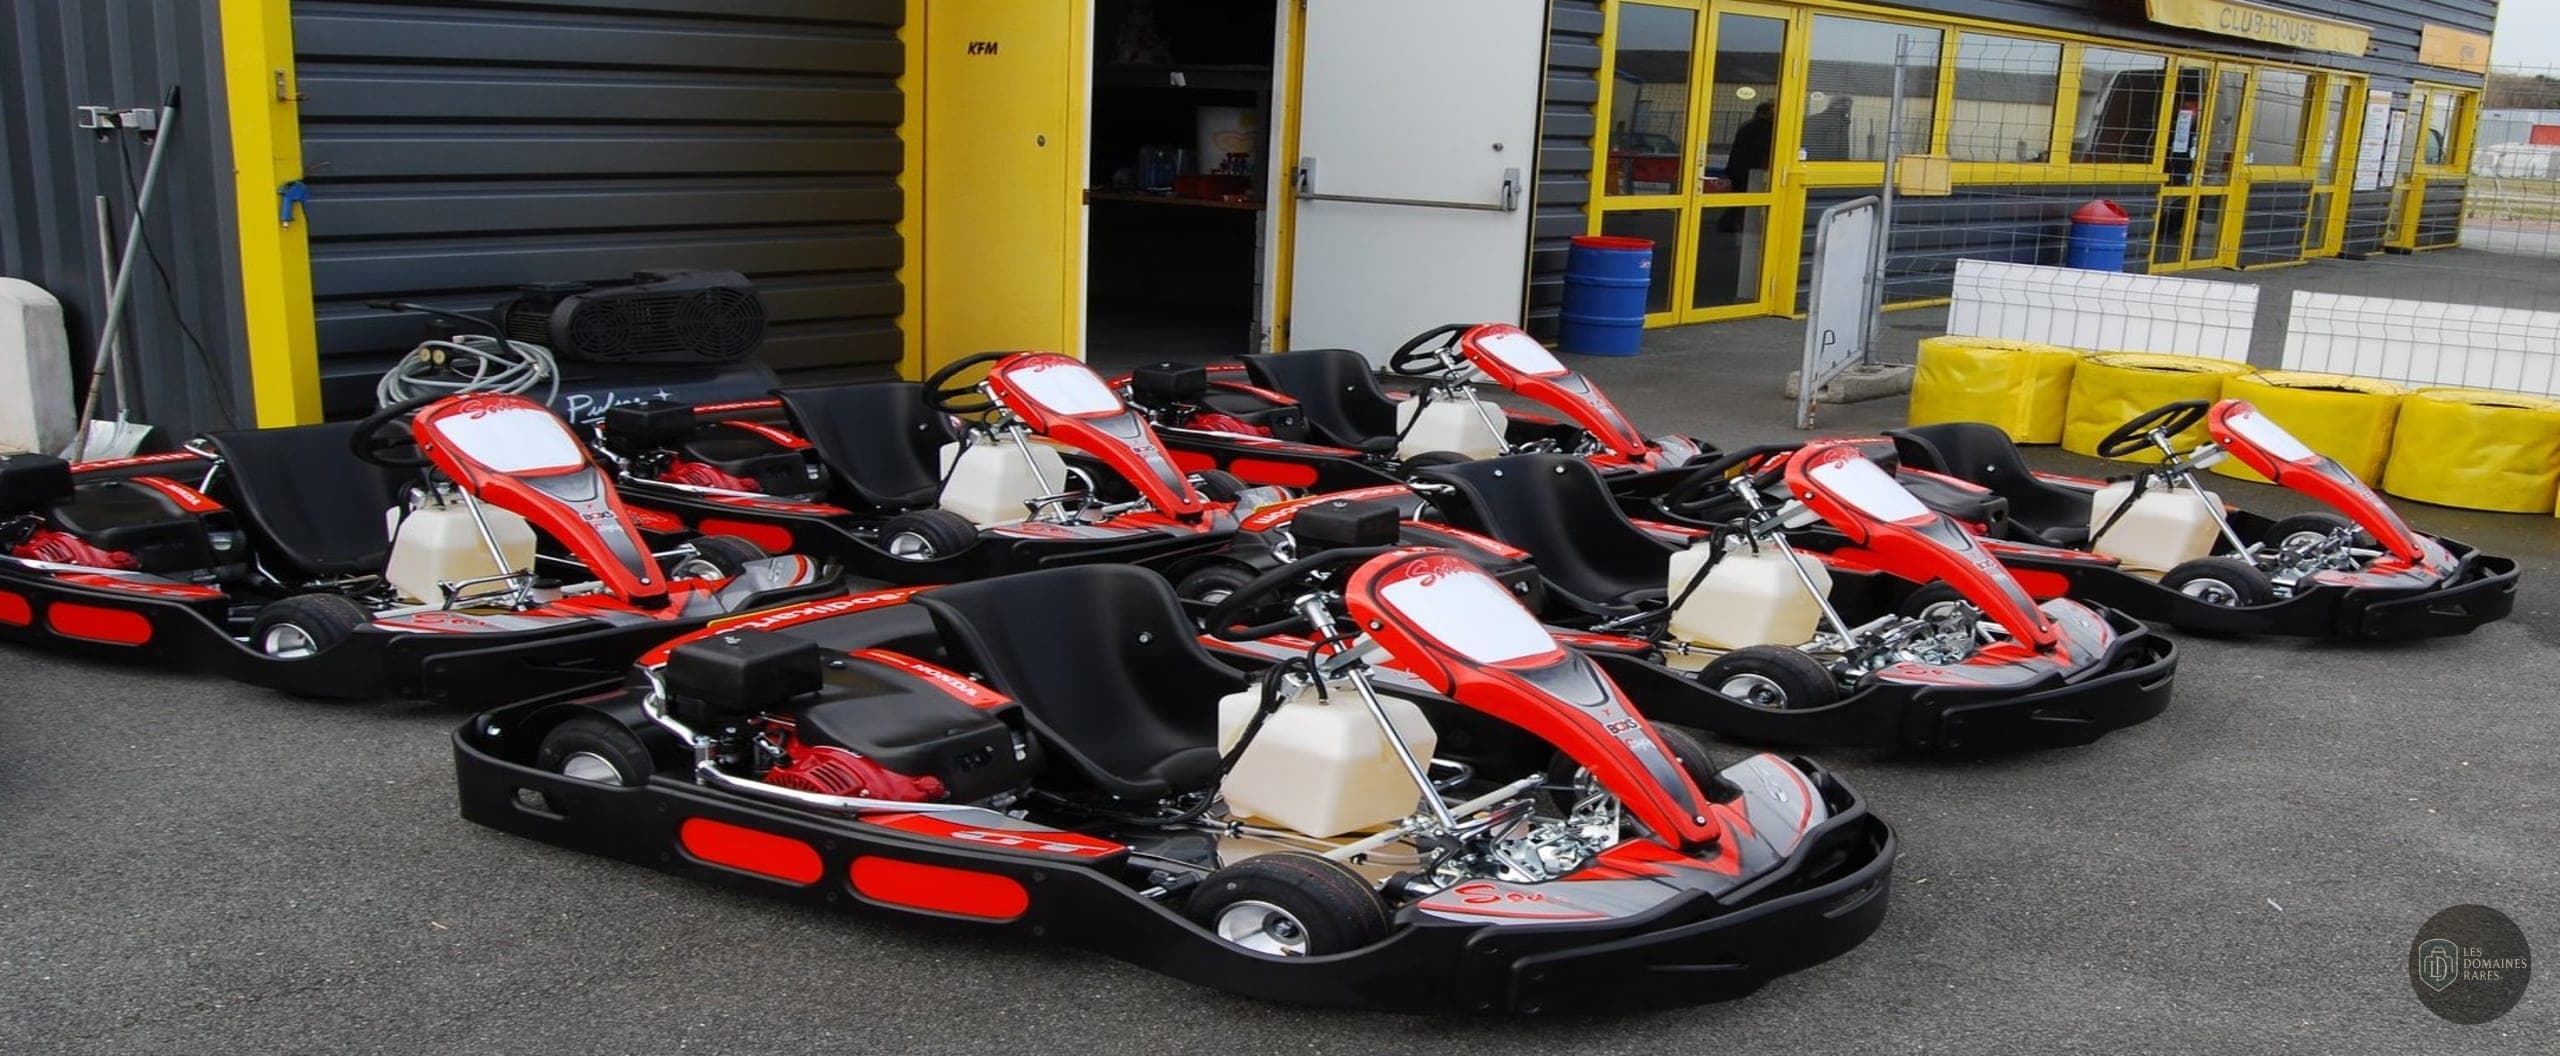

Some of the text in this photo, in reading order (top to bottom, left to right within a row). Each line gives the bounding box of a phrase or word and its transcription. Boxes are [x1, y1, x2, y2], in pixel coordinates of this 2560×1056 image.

[2220, 7, 2316, 44] CLUB-HOUSE
[967, 41, 998, 55] KFM
[910, 664, 978, 697] HONDA
